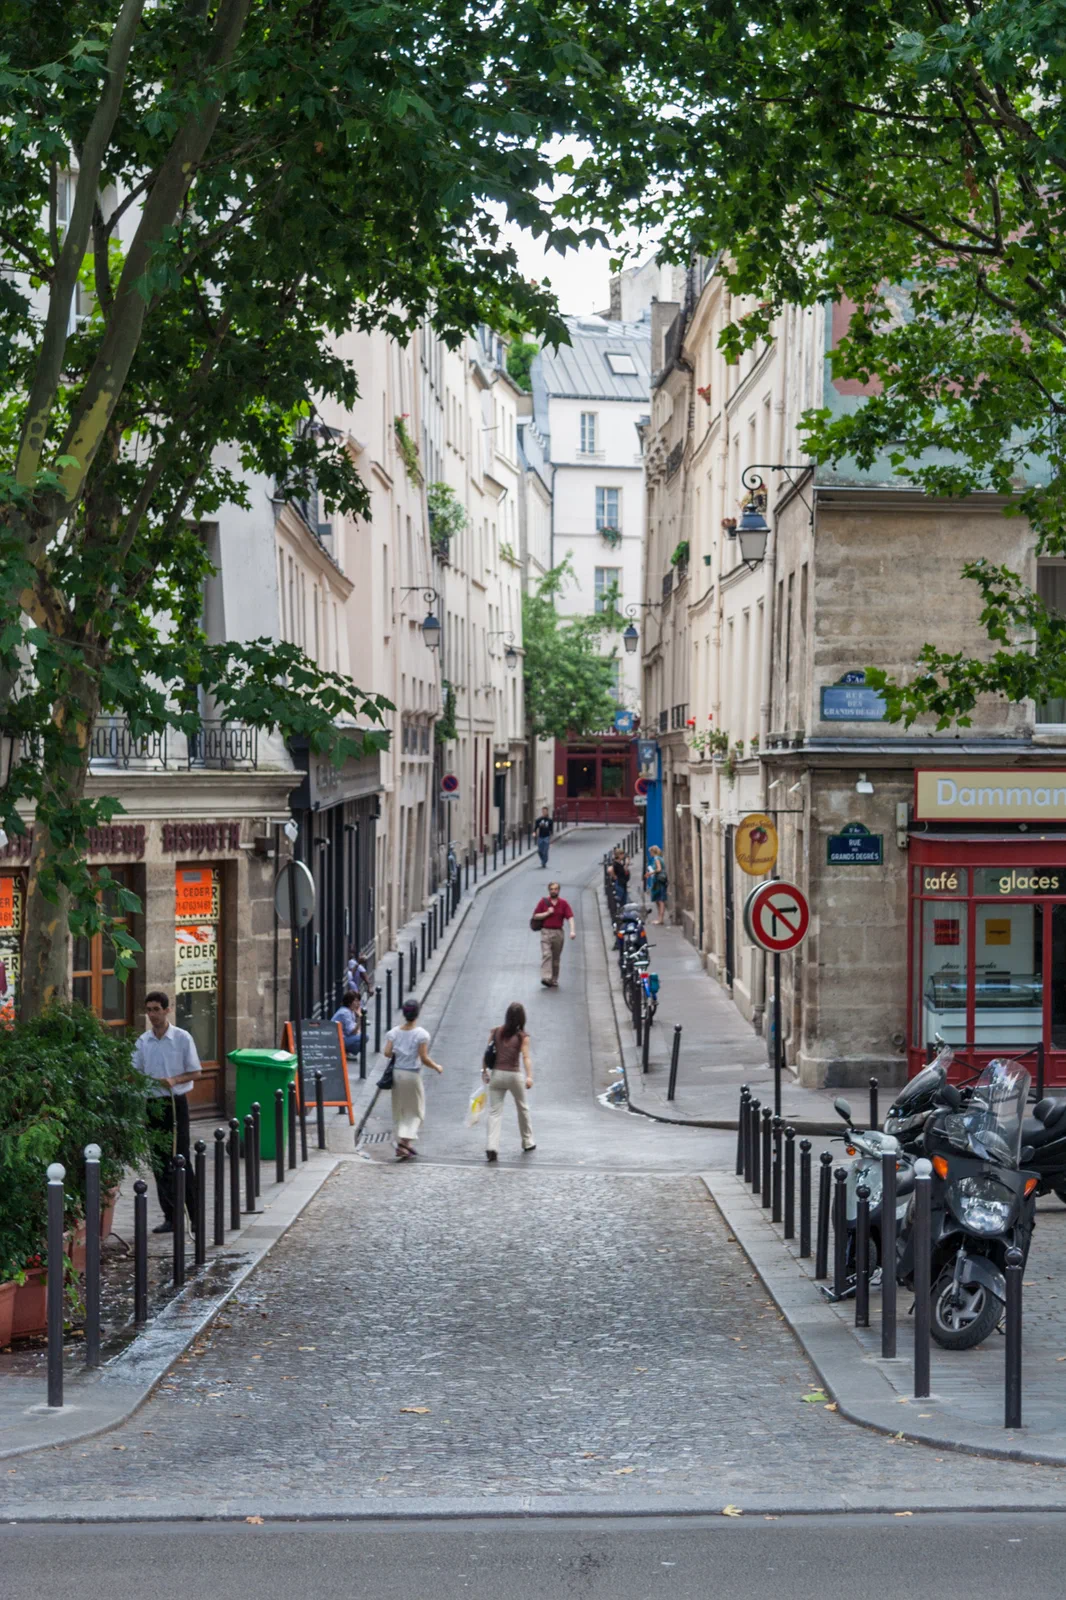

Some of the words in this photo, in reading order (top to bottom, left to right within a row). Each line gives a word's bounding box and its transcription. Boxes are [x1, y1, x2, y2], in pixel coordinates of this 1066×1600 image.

[924, 872, 958, 890] café
[999, 870, 1060, 894] glaces
[183, 887, 210, 897] CEDER
[179, 944, 216, 959] CEDER
[181, 975, 218, 990] CEDER
